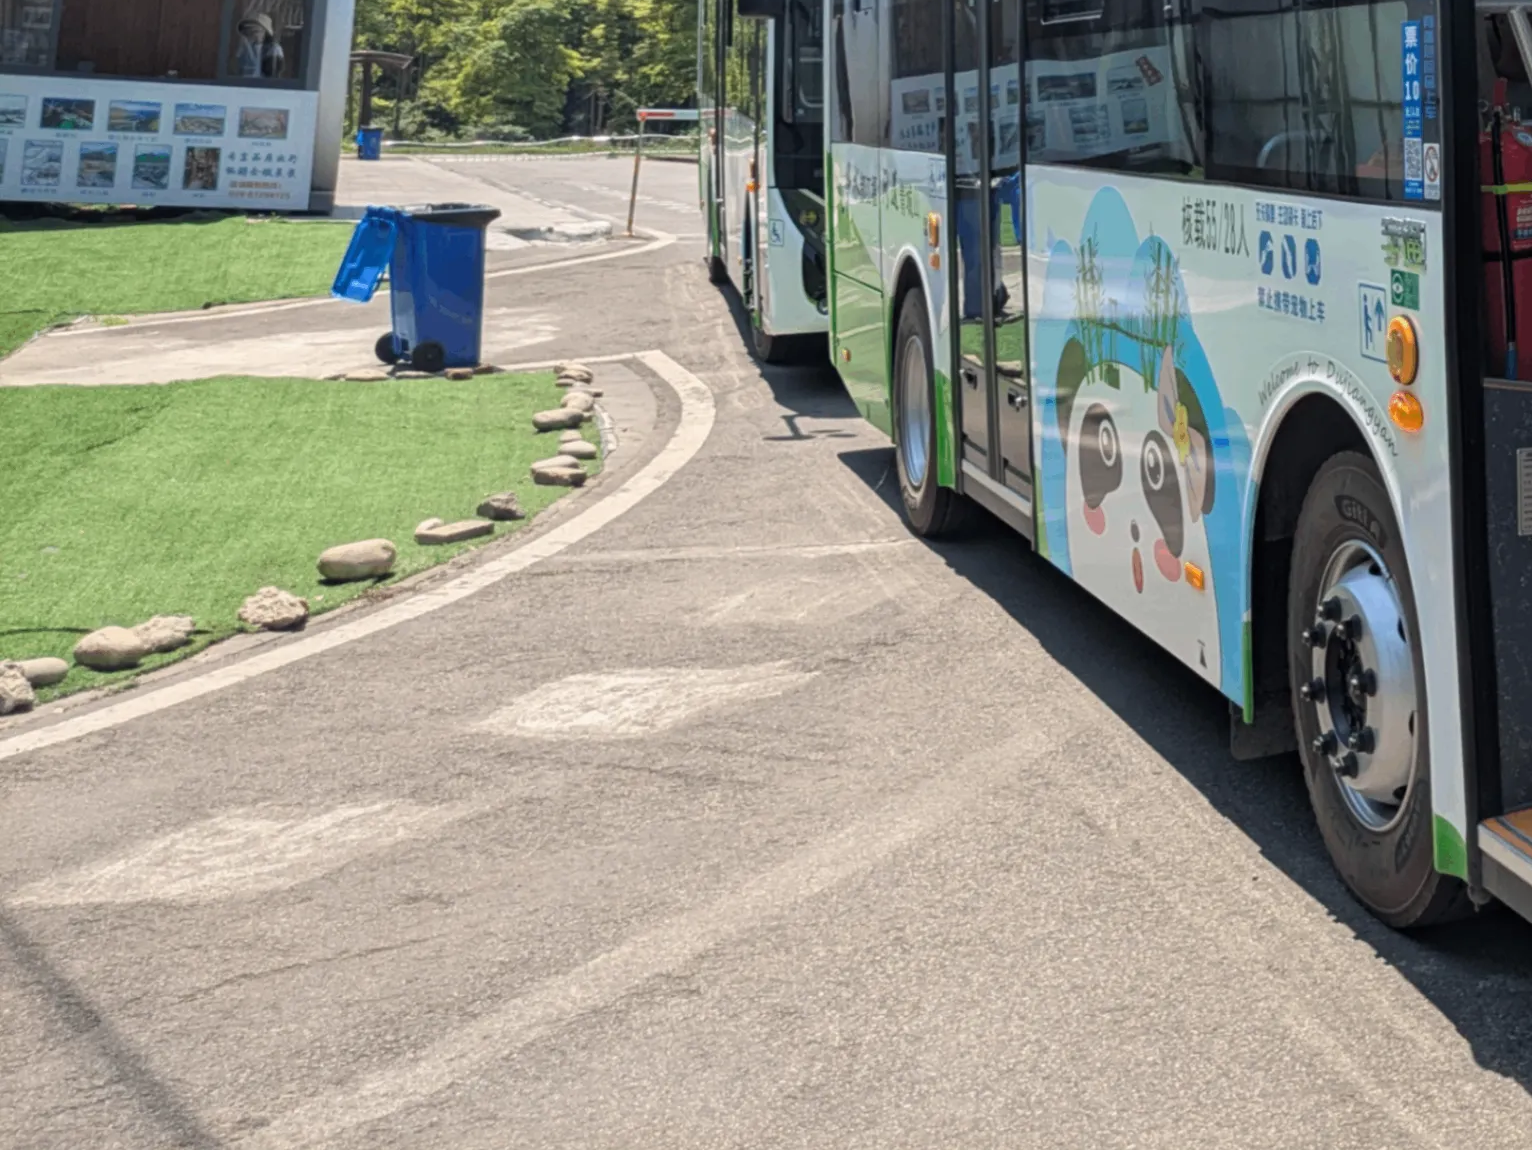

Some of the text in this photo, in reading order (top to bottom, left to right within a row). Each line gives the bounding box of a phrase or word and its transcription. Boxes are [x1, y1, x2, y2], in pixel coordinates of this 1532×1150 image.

[1182, 196, 1250, 258] 核载55/28人
[1258, 356, 1398, 457] Welcome to Dujiangyan
